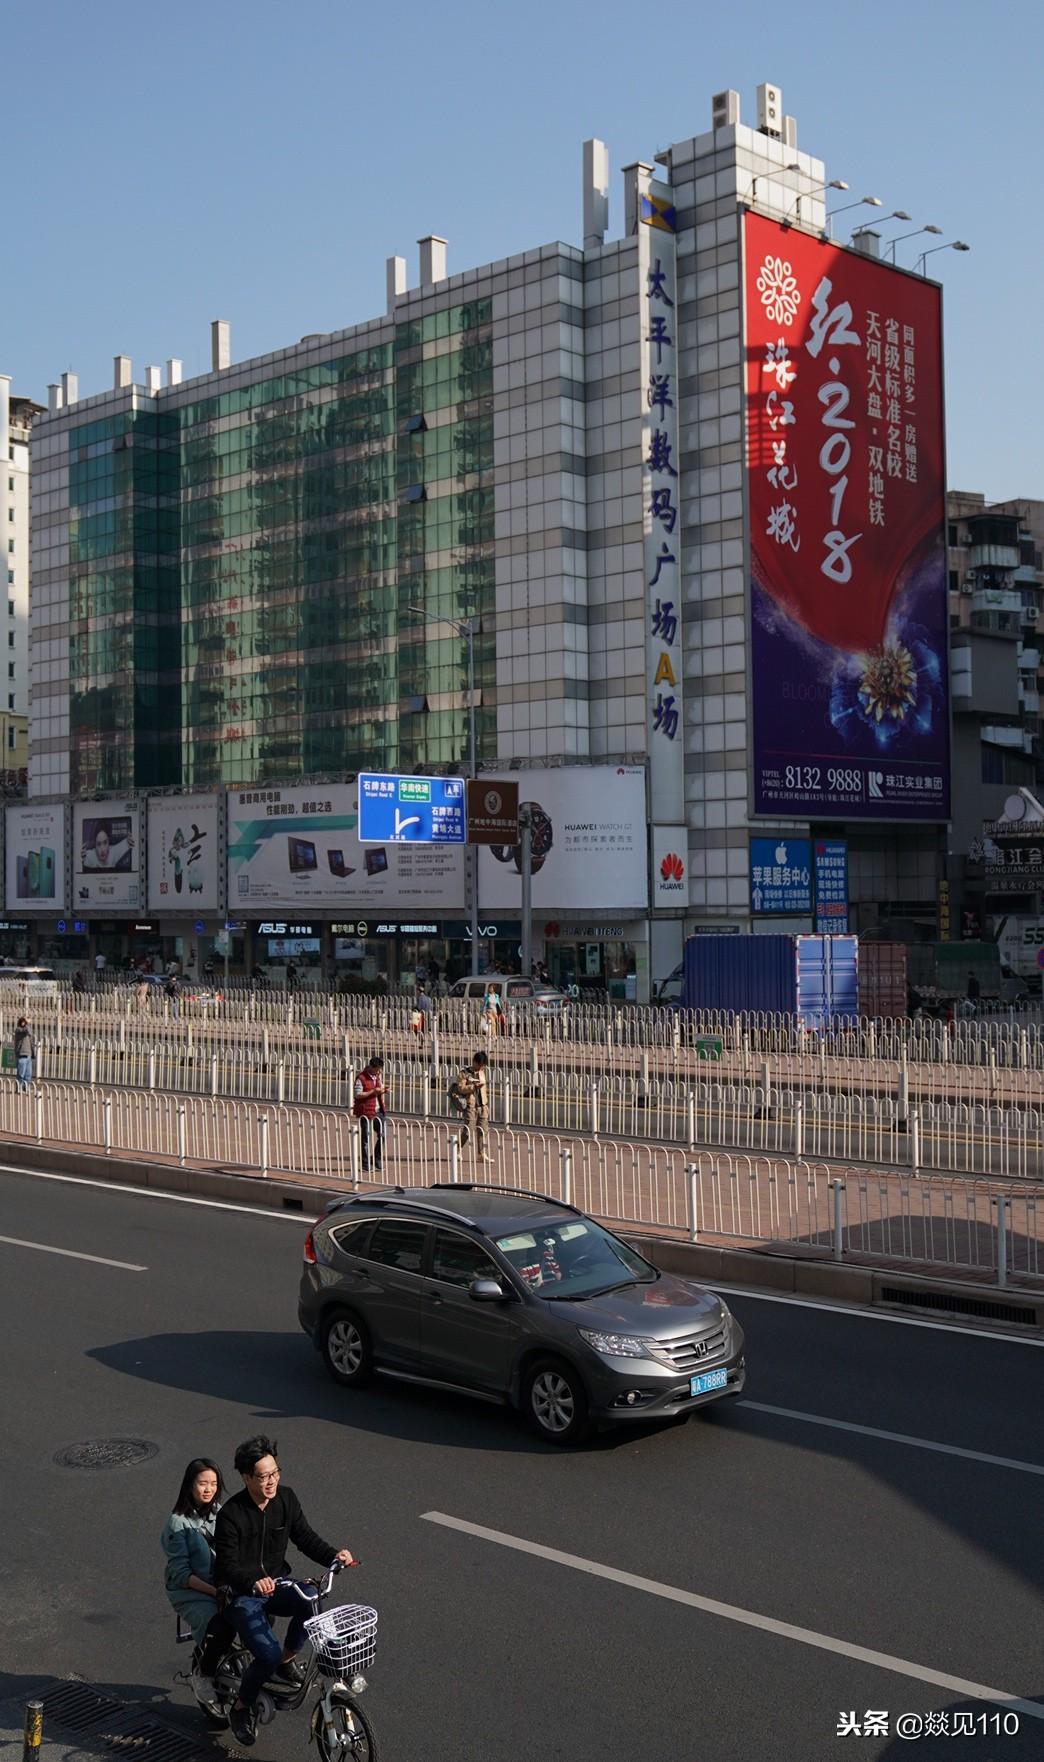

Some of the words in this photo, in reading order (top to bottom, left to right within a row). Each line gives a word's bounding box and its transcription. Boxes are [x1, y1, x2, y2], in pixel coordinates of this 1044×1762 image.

[885, 317, 902, 479] 省级标准名校
[903, 324, 918, 483] 同面积多一房赠送
[866, 310, 885, 527] 天河大盘·双地铁
[763, 337, 800, 553] 珠江花城
[363, 780, 395, 792] 石牌东路
[785, 765, 822, 790] 8132
[827, 768, 862, 792] 9888
[885, 774, 943, 790] 珠江实业集团
[564, 823, 597, 831] HUAWEI
[599, 823, 623, 831] WATCH
[816, 857, 845, 867] SAMSUNG
[752, 865, 810, 887] 苹果服务中心
[659, 882, 685, 891] HUAWEI
[257, 923, 288, 934] ASUS
[376, 925, 398, 933] ASUS
